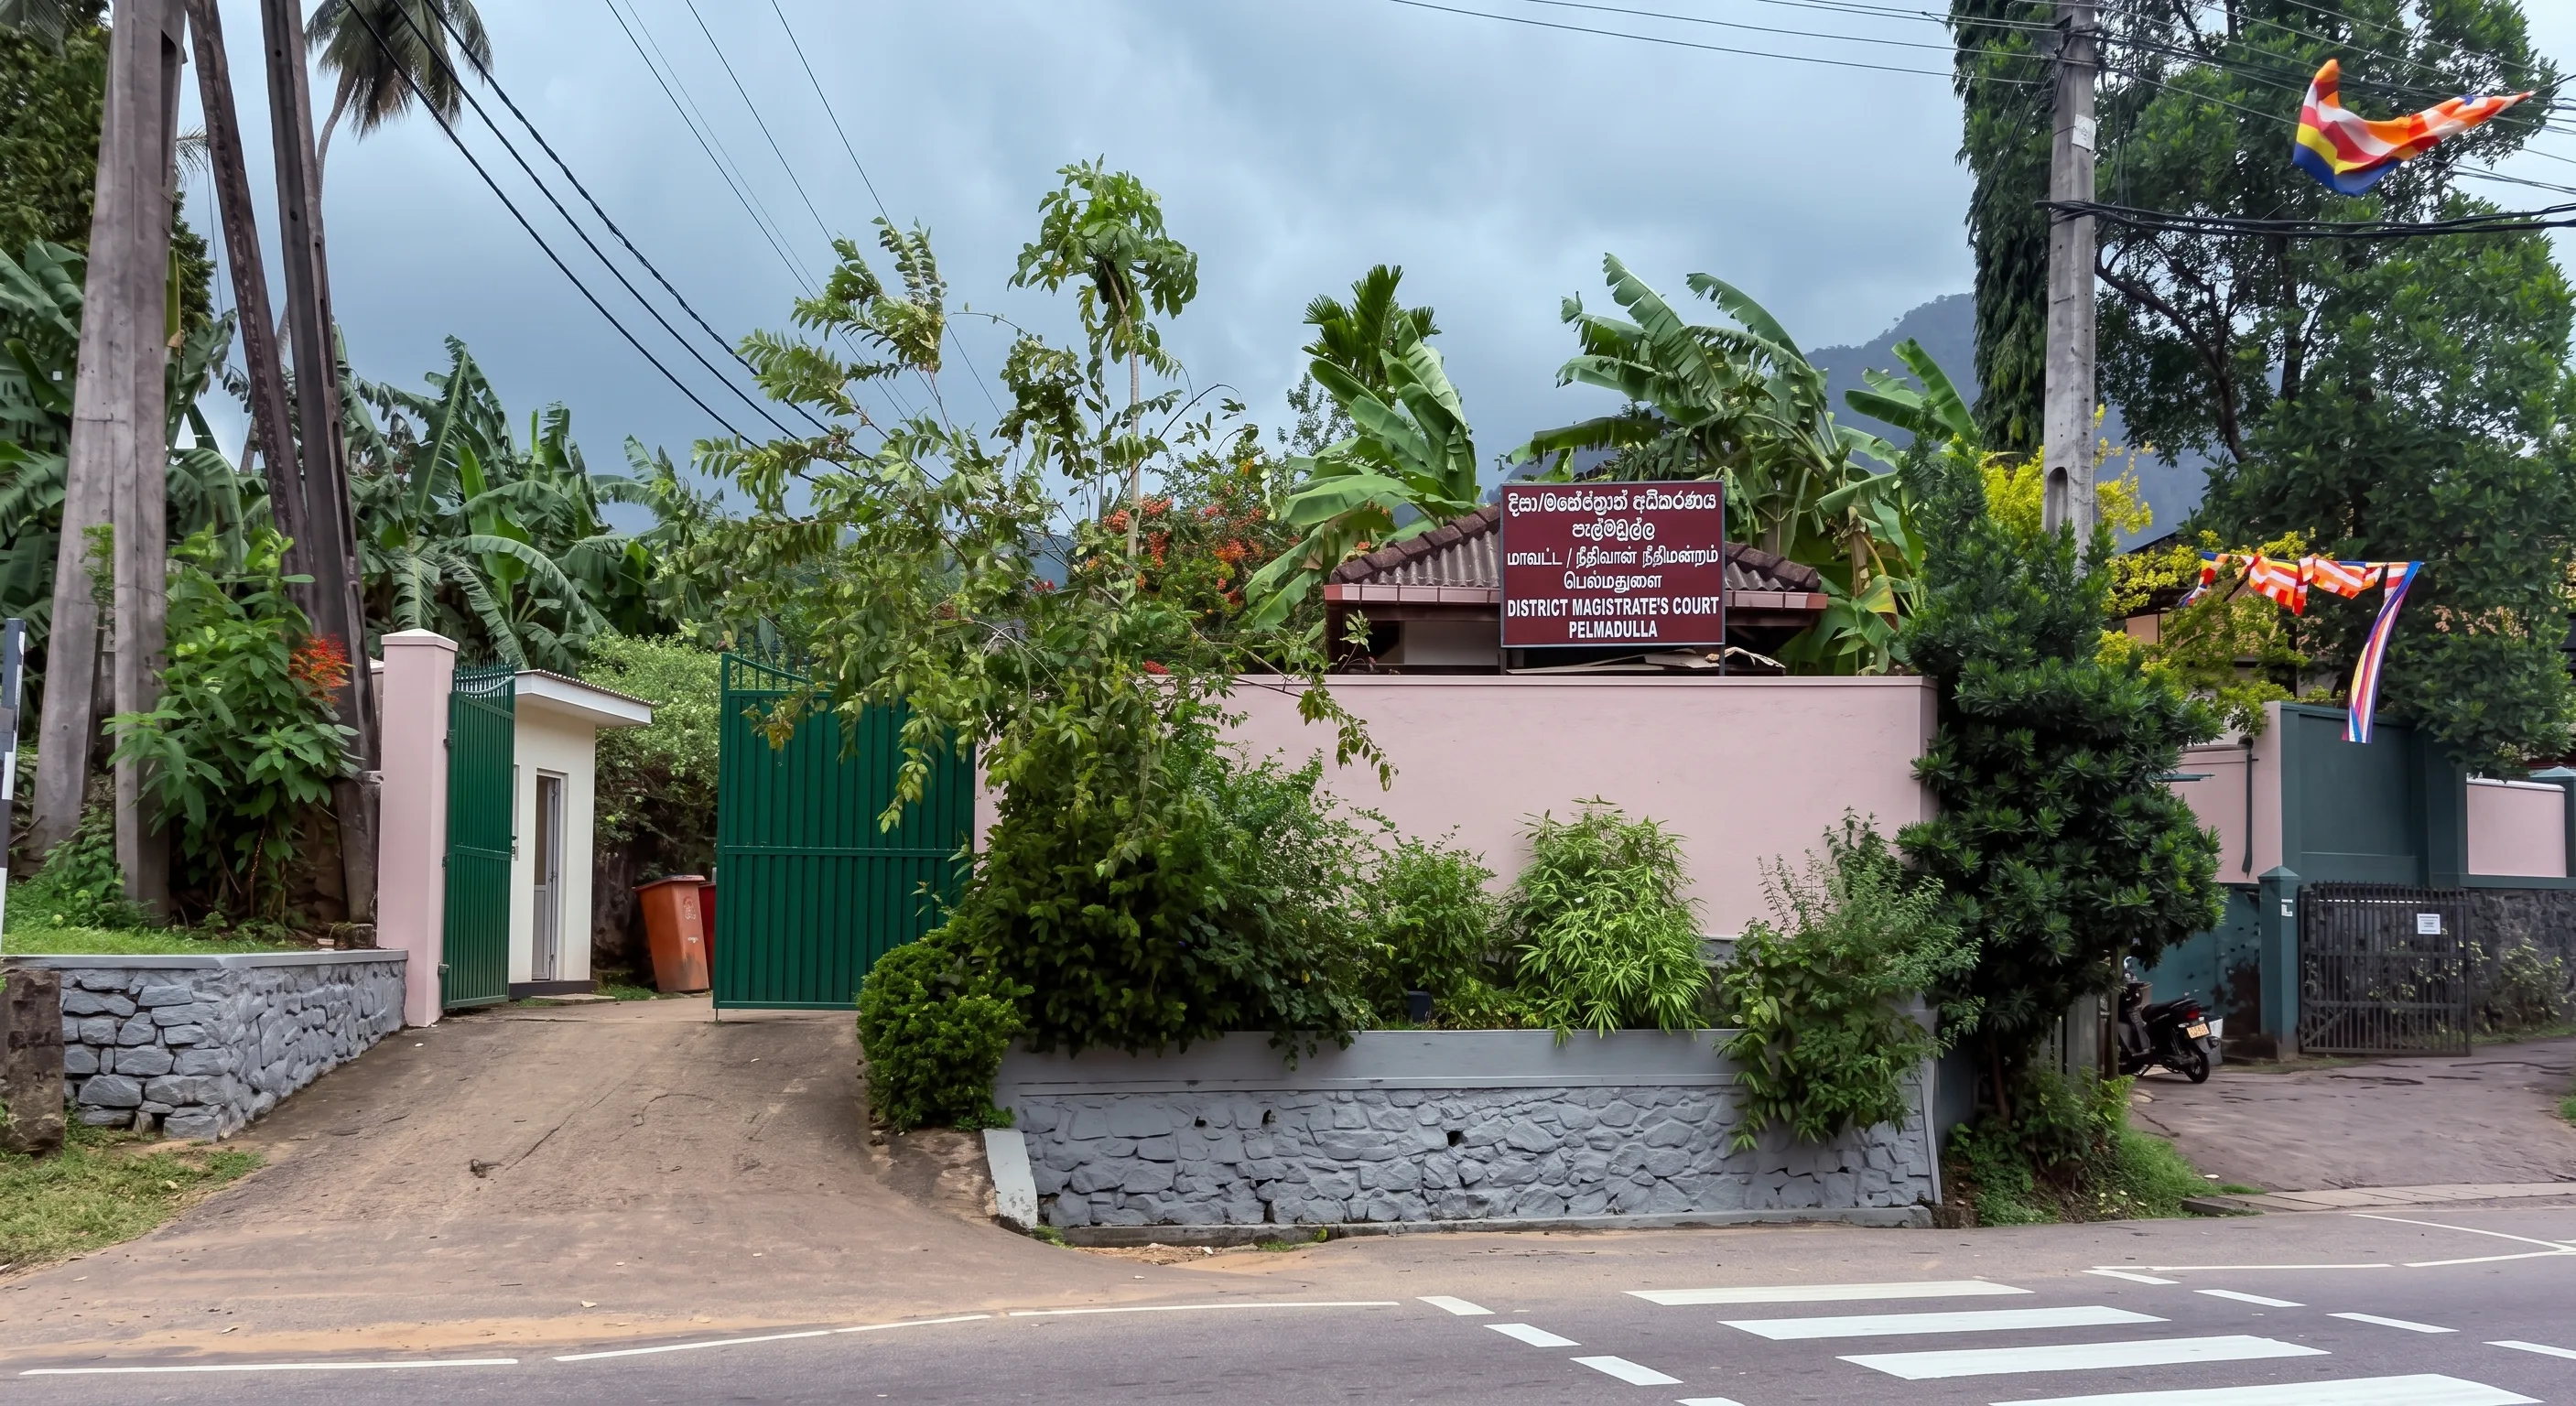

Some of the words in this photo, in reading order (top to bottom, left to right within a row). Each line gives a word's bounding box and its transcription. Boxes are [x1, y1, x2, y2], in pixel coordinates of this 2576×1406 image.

[1507, 546, 1563, 566] மாவட்ட
[1575, 545, 1638, 569] நீதிவான்
[1641, 544, 1719, 568] நீதிமன்றம்
[1563, 569, 1662, 594] பெல்மதுளை
[1507, 599, 1569, 617] DISTRICT
[1572, 597, 1670, 616] MAGISTRATE'S
[1672, 596, 1720, 615] COURT
[1568, 620, 1659, 639] PELMADULLA
